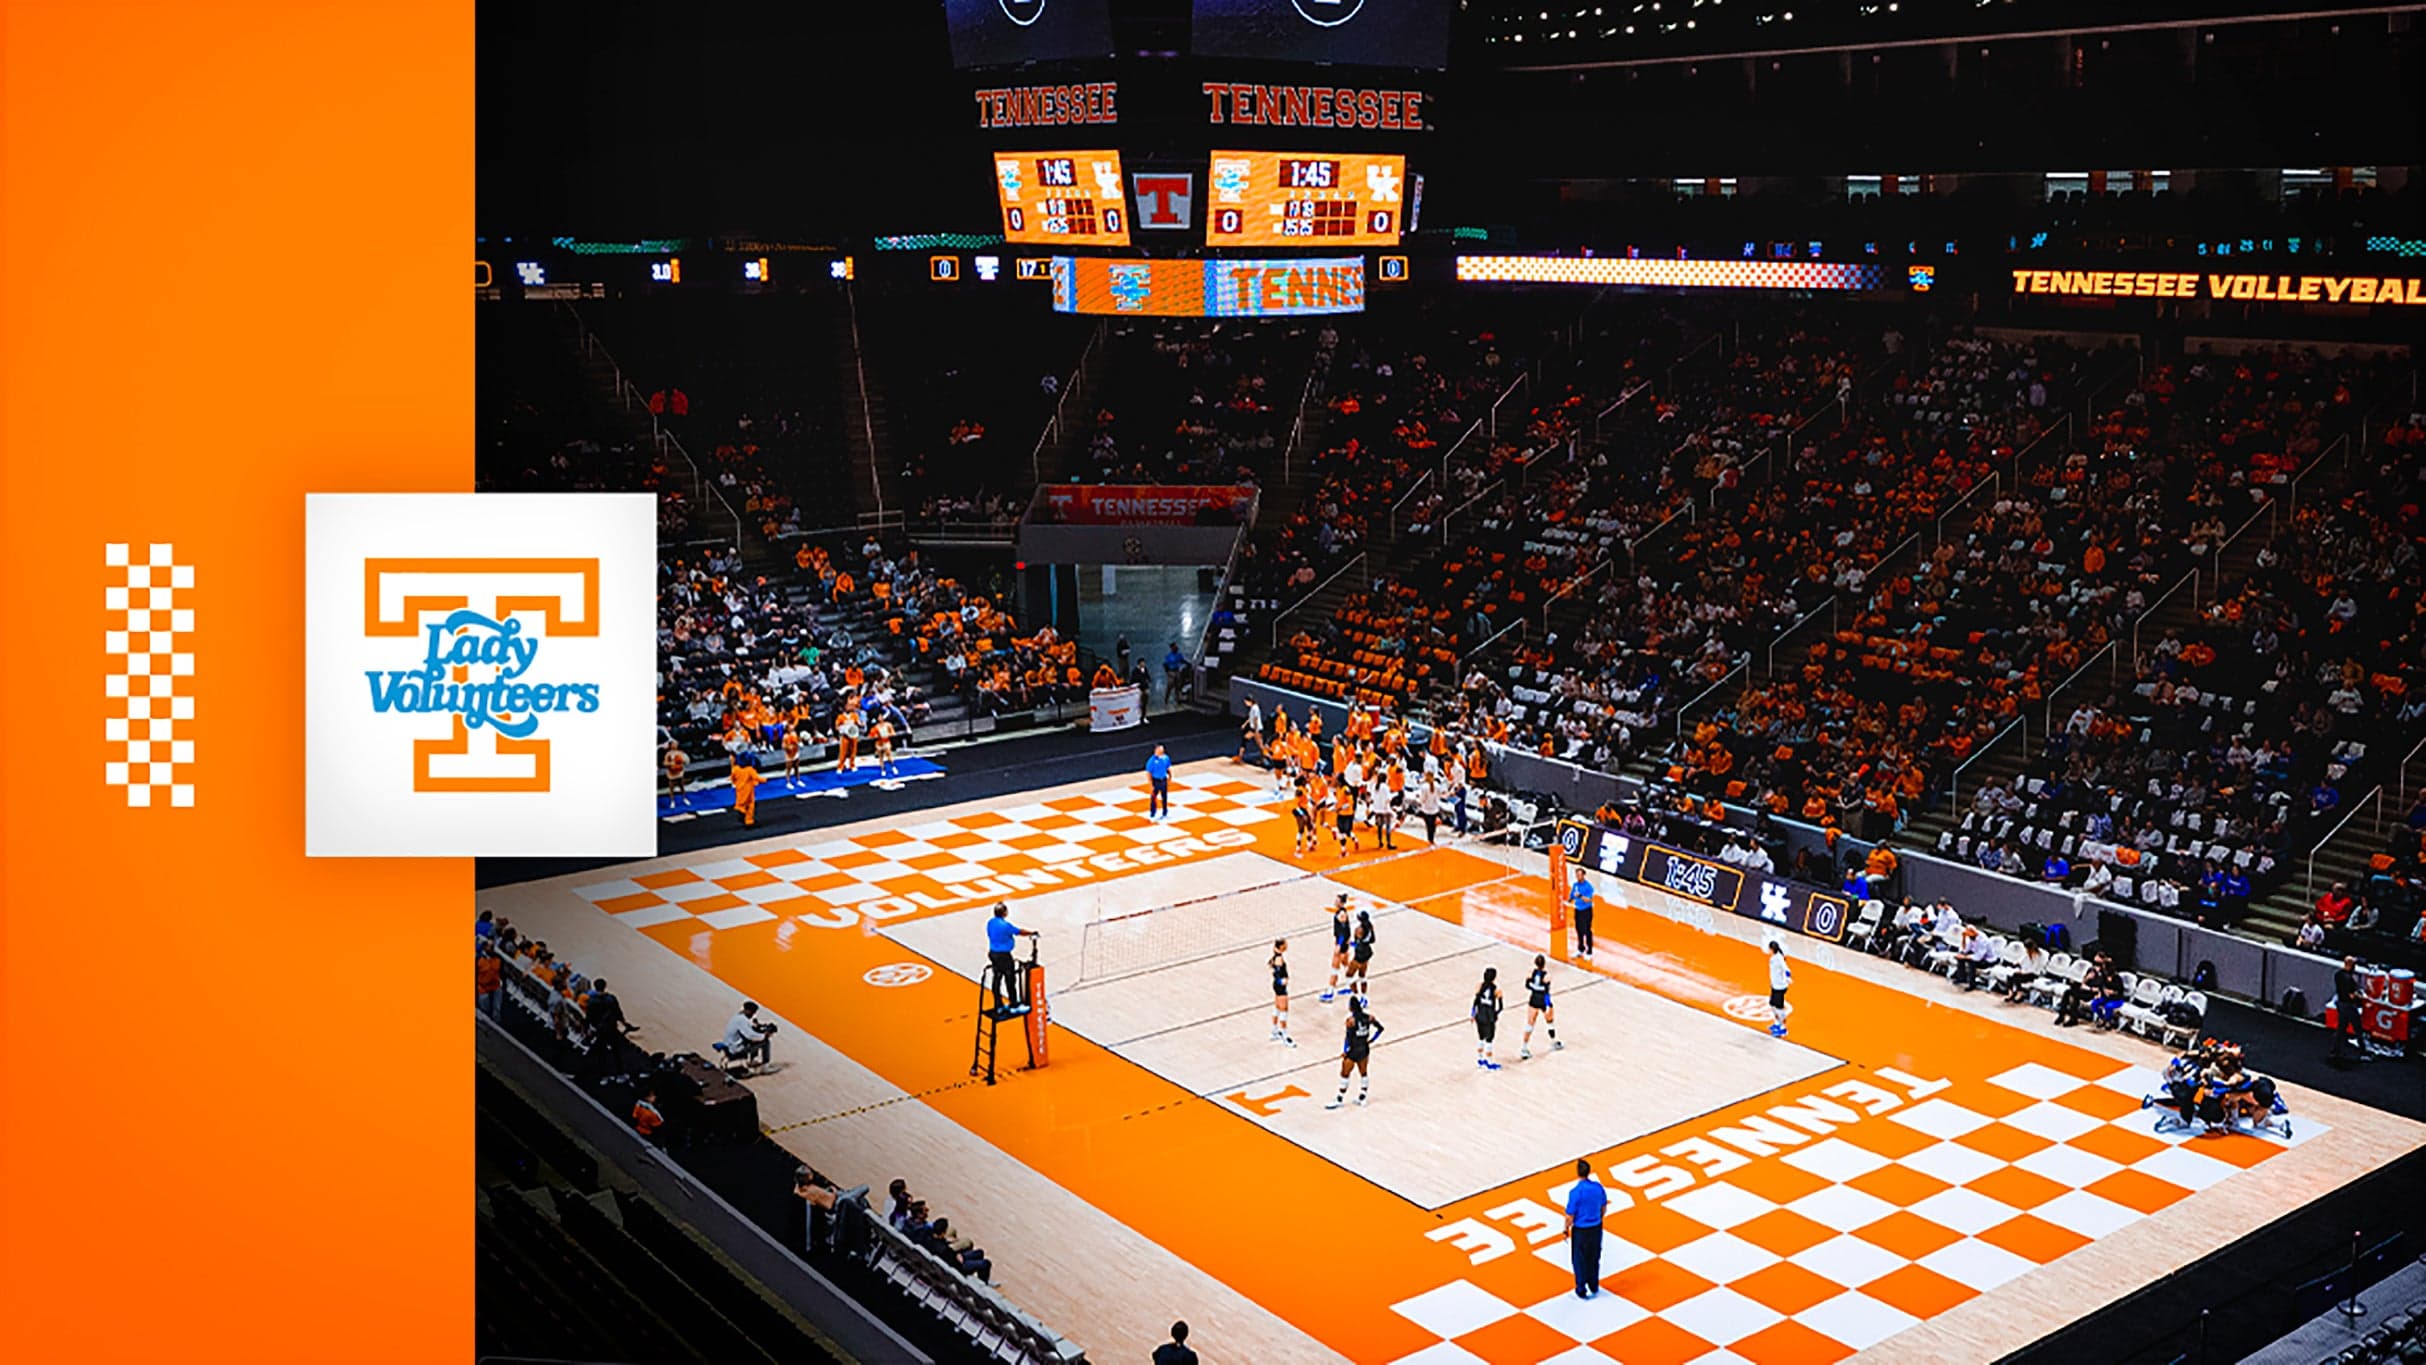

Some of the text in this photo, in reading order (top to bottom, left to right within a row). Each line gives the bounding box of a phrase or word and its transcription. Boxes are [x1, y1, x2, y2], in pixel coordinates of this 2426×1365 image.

[976, 82, 1117, 128] TENNESSEE
[1203, 82, 1423, 130] TENNESSEE
[1043, 159, 1073, 185] 1:45
[1291, 161, 1331, 187] 1:45
[1137, 177, 1188, 223] T
[1011, 209, 1022, 230] 0
[1107, 209, 1119, 231] 0
[1222, 211, 1238, 232] 0
[1373, 212, 1388, 232] 0
[939, 259, 951, 277] 0
[1387, 259, 1401, 278] 0
[2012, 270, 2426, 304] TENNESSEE VOLLEYBAL
[1562, 827, 1579, 855] 0
[799, 828, 1258, 929] VOLUNTEERS
[1664, 856, 1717, 899] 1:45
[1815, 902, 1837, 934] 0
